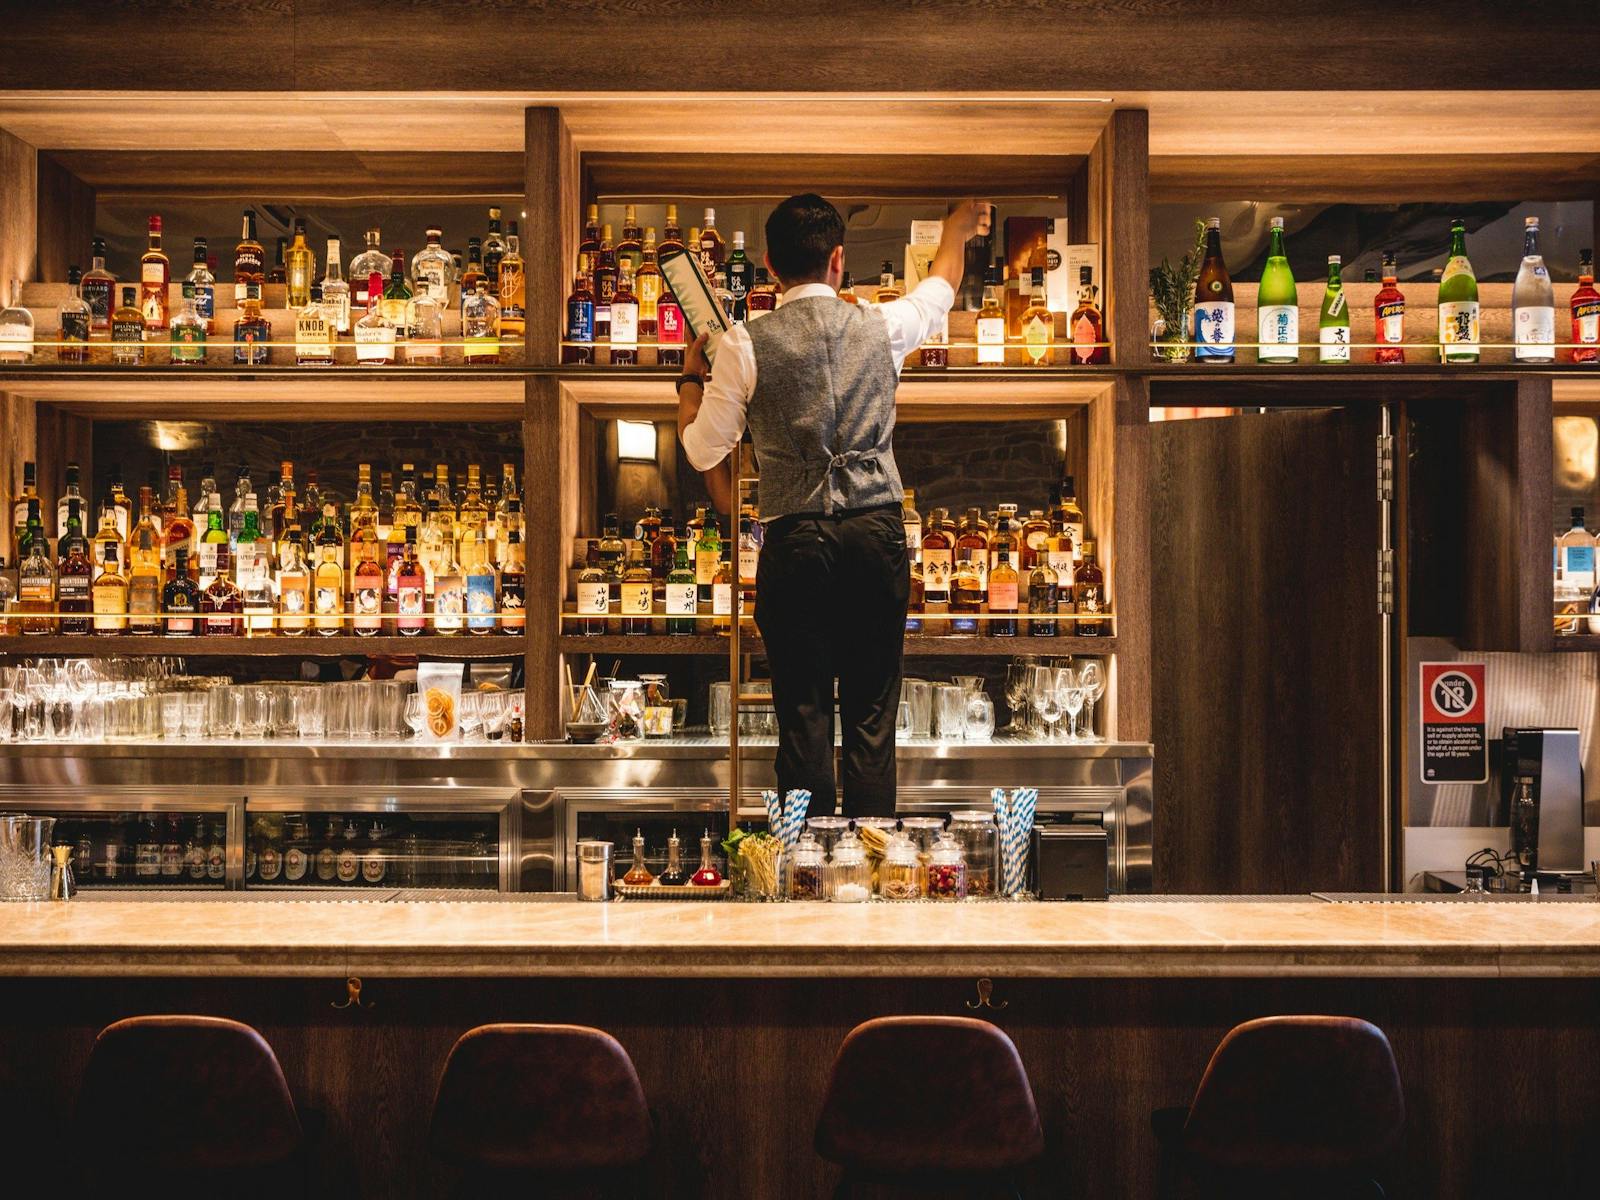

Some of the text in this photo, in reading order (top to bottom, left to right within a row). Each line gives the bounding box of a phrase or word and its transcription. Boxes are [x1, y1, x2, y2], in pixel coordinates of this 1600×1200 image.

[299, 320, 324, 331] KNOB
[927, 561, 950, 575] 余市
[1443, 679, 1465, 687] under
[1441, 687, 1465, 709] 18
